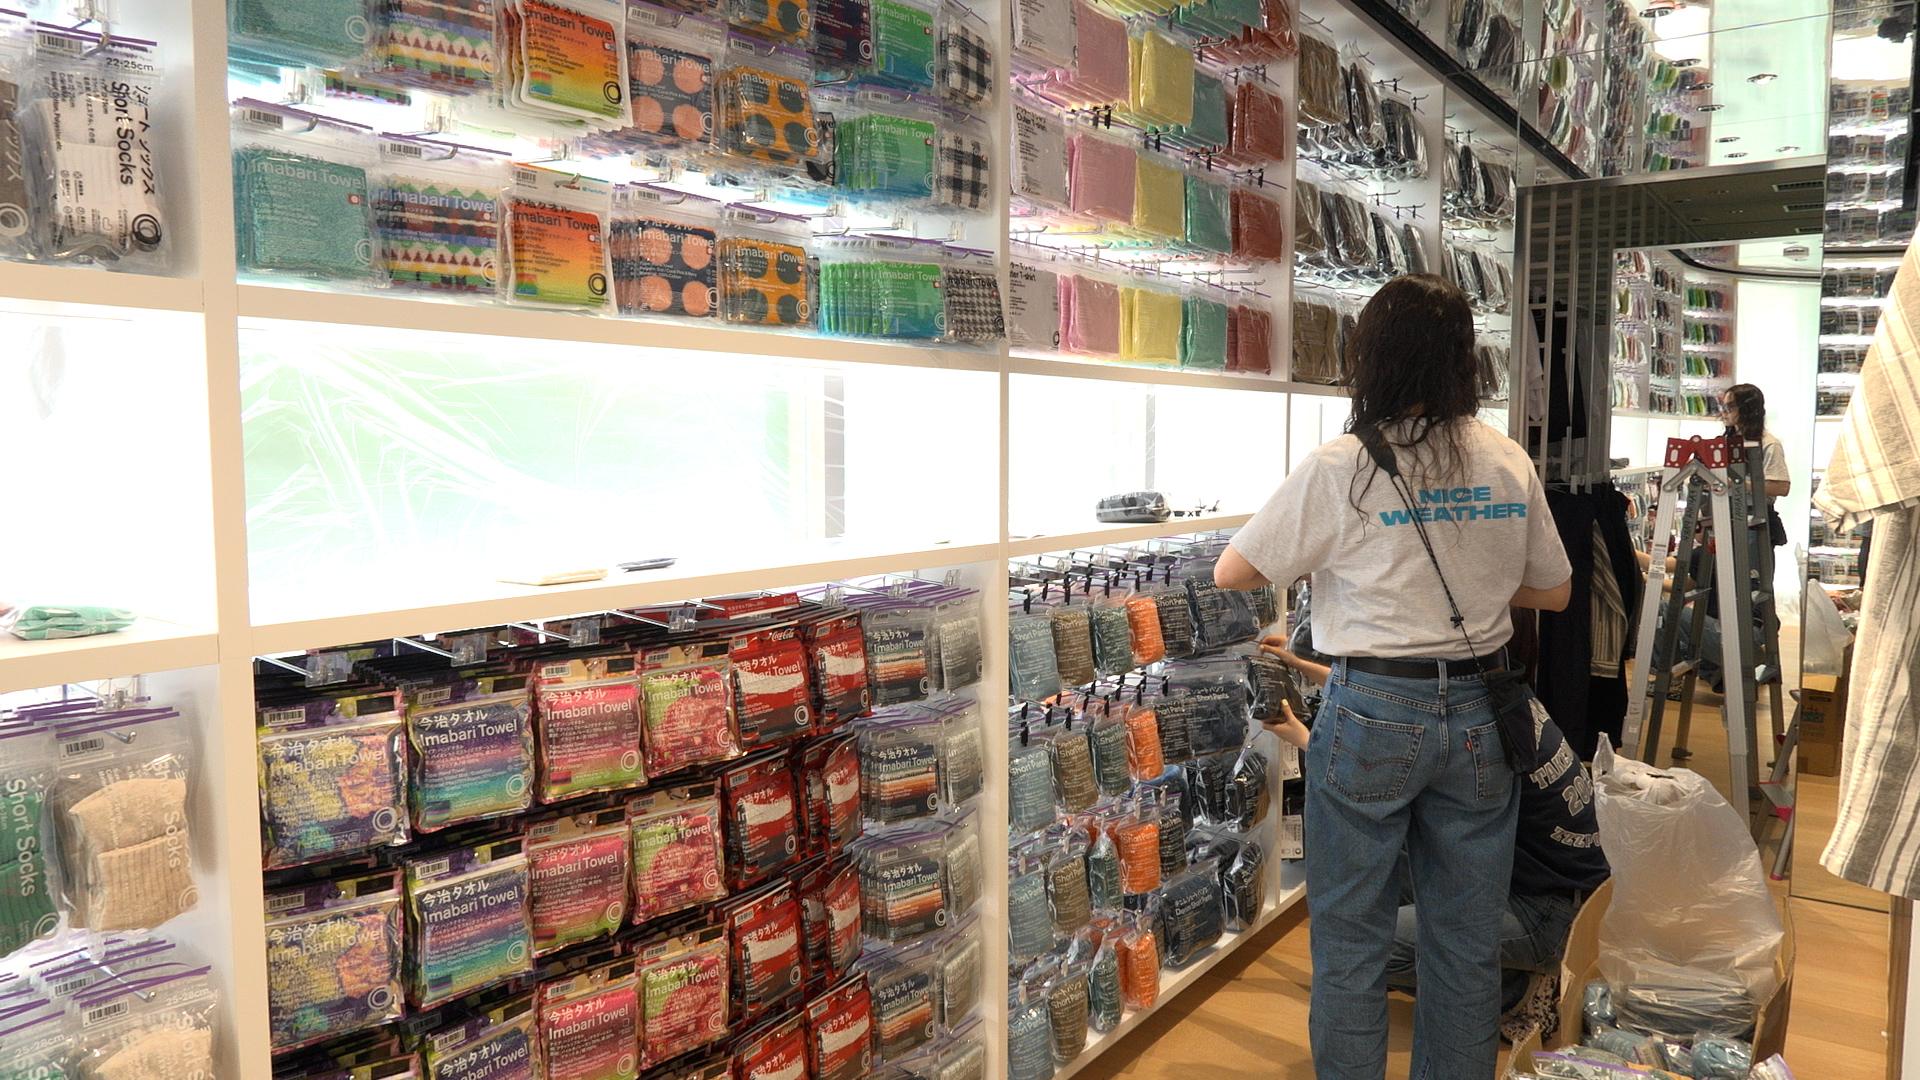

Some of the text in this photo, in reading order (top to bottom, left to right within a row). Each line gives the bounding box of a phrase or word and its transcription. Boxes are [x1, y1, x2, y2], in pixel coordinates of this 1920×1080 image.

[524, 8, 575, 29] Imabari
[116, 127, 137, 185] Socks
[391, 190, 449, 207] Imabari
[512, 210, 561, 227] Imabari
[639, 228, 683, 244] Imabari
[947, 276, 974, 289] mabari
[1418, 486, 1491, 504] NICE
[1378, 502, 1528, 527] WEATHER
[874, 643, 904, 654] Imabari
[648, 671, 699, 687] 今治タオル
[773, 661, 801, 678] Towel
[547, 688, 606, 706] 今治タオル
[647, 679, 724, 703] Imabari Towel
[419, 709, 488, 730] 今治タオル
[547, 700, 632, 721] Imabari Towel
[419, 720, 518, 747] Imabari Towel
[271, 735, 347, 758] 今治タオル
[879, 747, 917, 761] 今治タオル
[270, 748, 387, 774] Imabari Towel
[879, 758, 912, 772] Imabari
[1009, 763, 1032, 776] Short
[6, 778, 39, 897] Short Socks
[164, 811, 181, 868] Socks
[634, 822, 712, 850] Imabari Towel
[533, 842, 592, 865] 今治タオル
[531, 851, 618, 881] Imabari Towel
[882, 862, 921, 880] 今治タオル
[883, 871, 939, 893] Imabari Towel
[422, 880, 490, 908] 今治タオル
[423, 902, 479, 924] Imabari
[481, 886, 519, 907] Towel
[269, 917, 347, 944] 今治タオル
[270, 930, 385, 963] Imabari Towel
[646, 960, 699, 983] 今治タオル
[646, 965, 720, 998] Imabari Towel
[548, 998, 606, 1025] 今治タオル
[548, 1005, 629, 1042] Imabari Towel
[440, 1044, 502, 1077] 今治タオル
[495, 1046, 528, 1069] Towel
